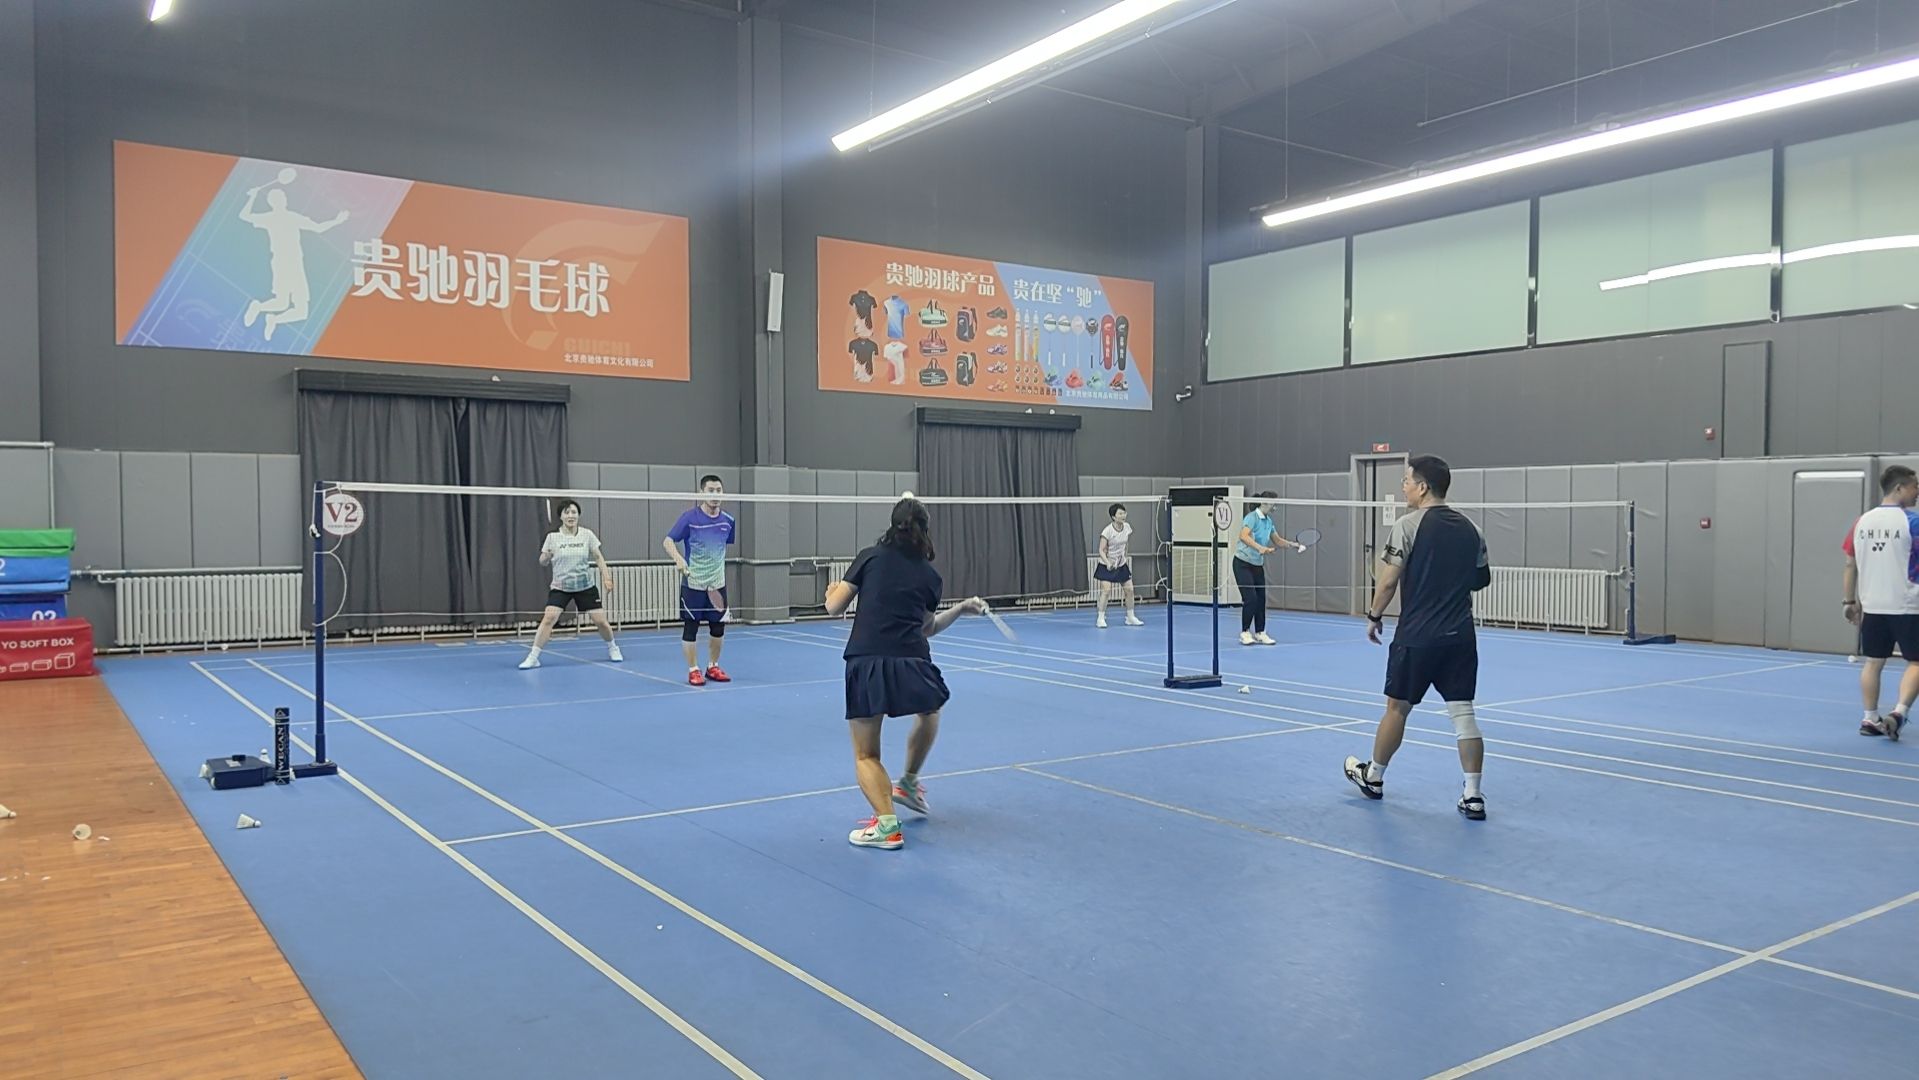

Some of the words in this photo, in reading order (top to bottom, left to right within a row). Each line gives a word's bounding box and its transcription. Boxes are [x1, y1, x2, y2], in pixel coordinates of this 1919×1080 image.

[351, 238, 610, 318] 贵驰羽毛球
[886, 262, 996, 297] 贵驰羽球产品
[325, 502, 358, 523] V2
[1860, 529, 1901, 540] CHINA
[1, 641, 18, 650] YO
[20, 639, 49, 649] SOFT
[51, 637, 75, 647] BOX
